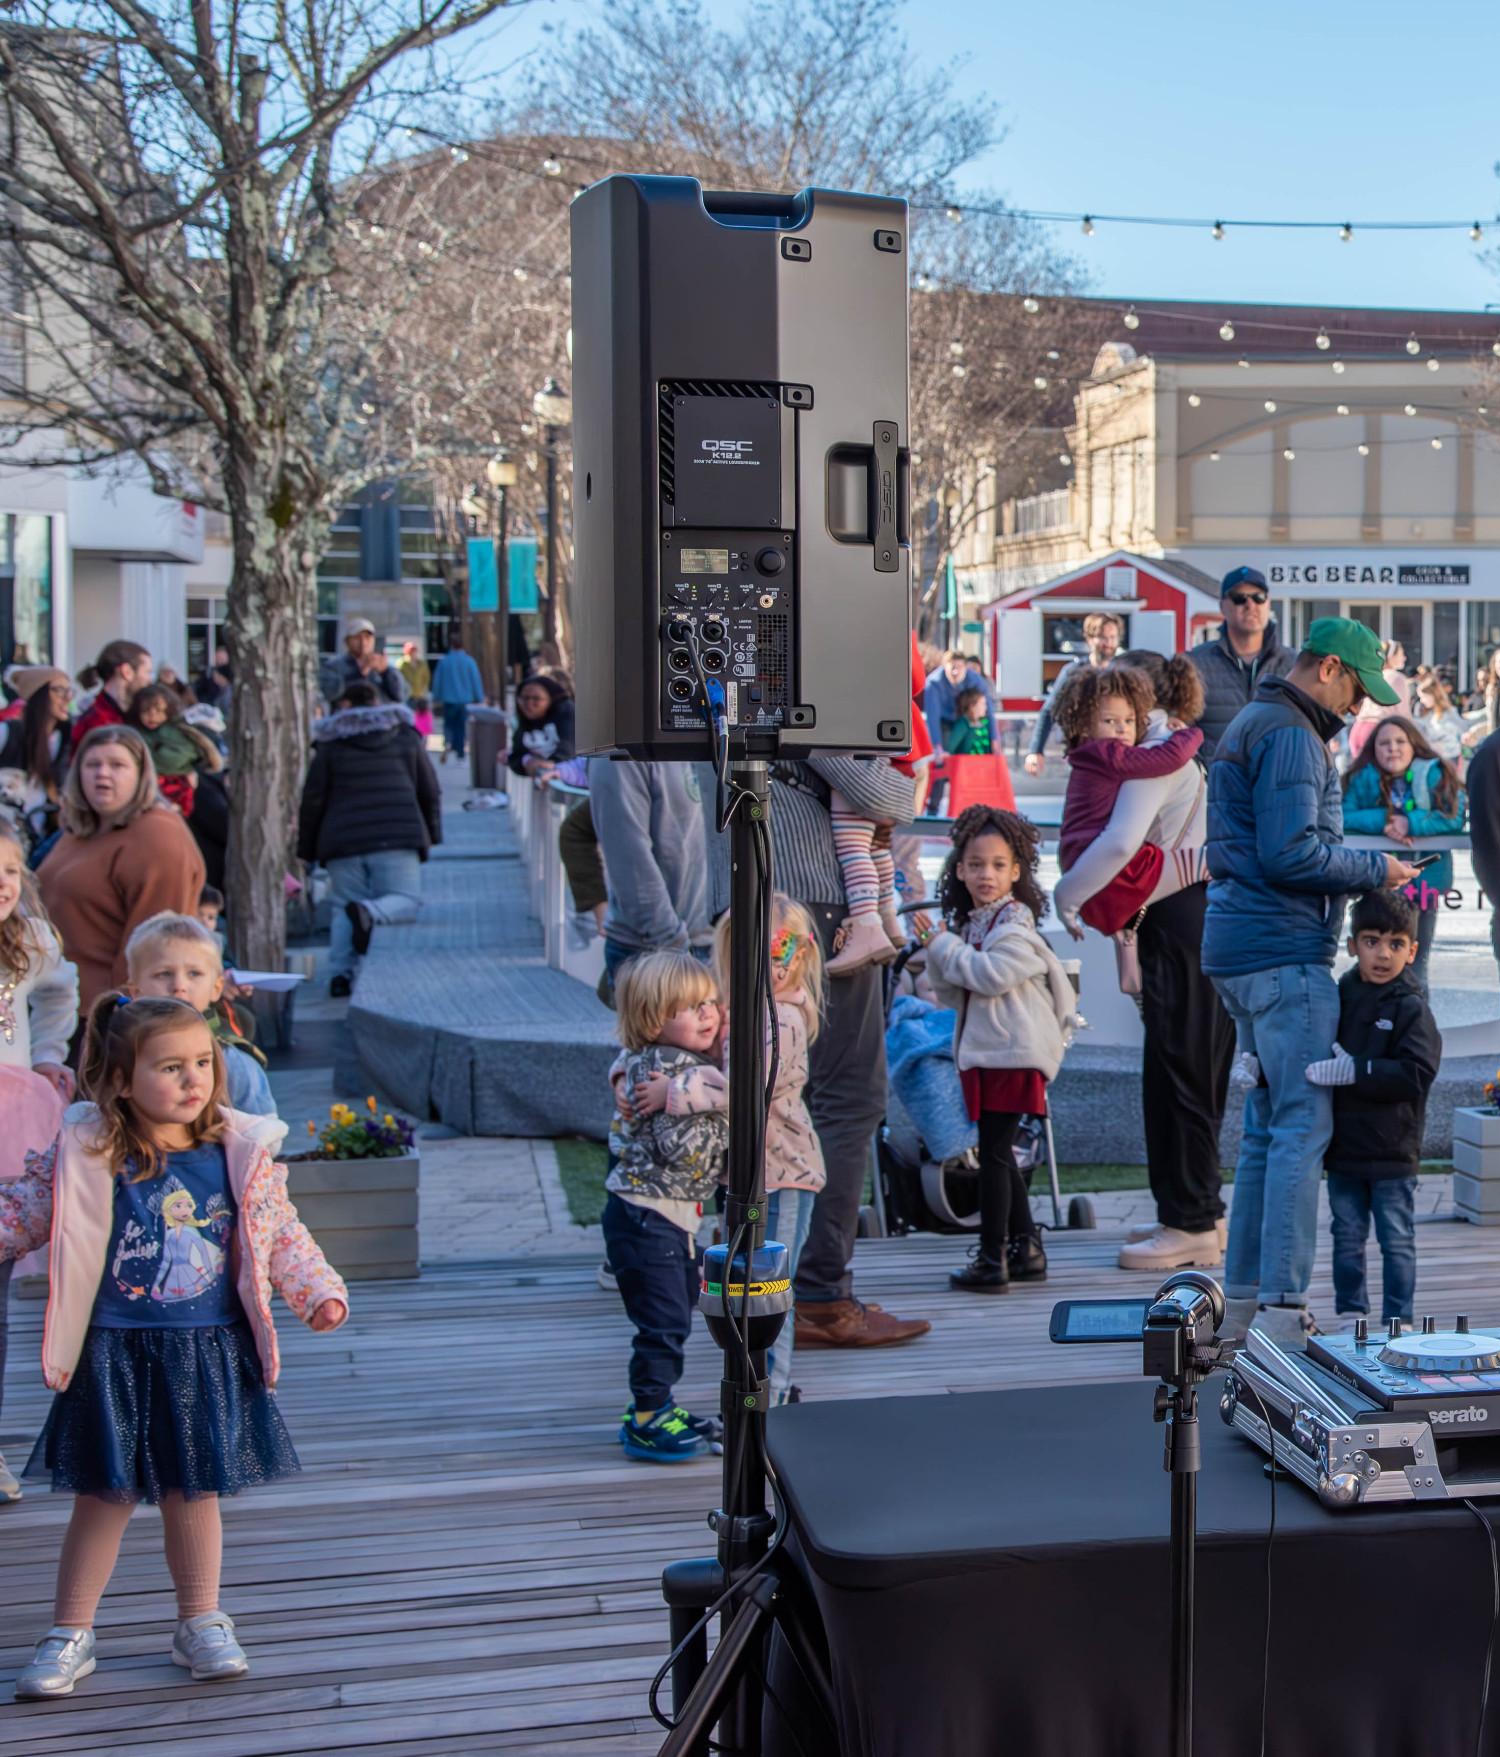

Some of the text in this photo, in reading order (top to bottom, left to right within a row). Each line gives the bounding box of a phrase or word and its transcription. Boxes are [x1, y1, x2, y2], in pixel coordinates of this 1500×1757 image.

[702, 439, 753, 452] QSC
[1270, 565, 1395, 584] BIG BEAR
[1402, 879, 1463, 912] the
[1428, 1405, 1489, 1424] serato
